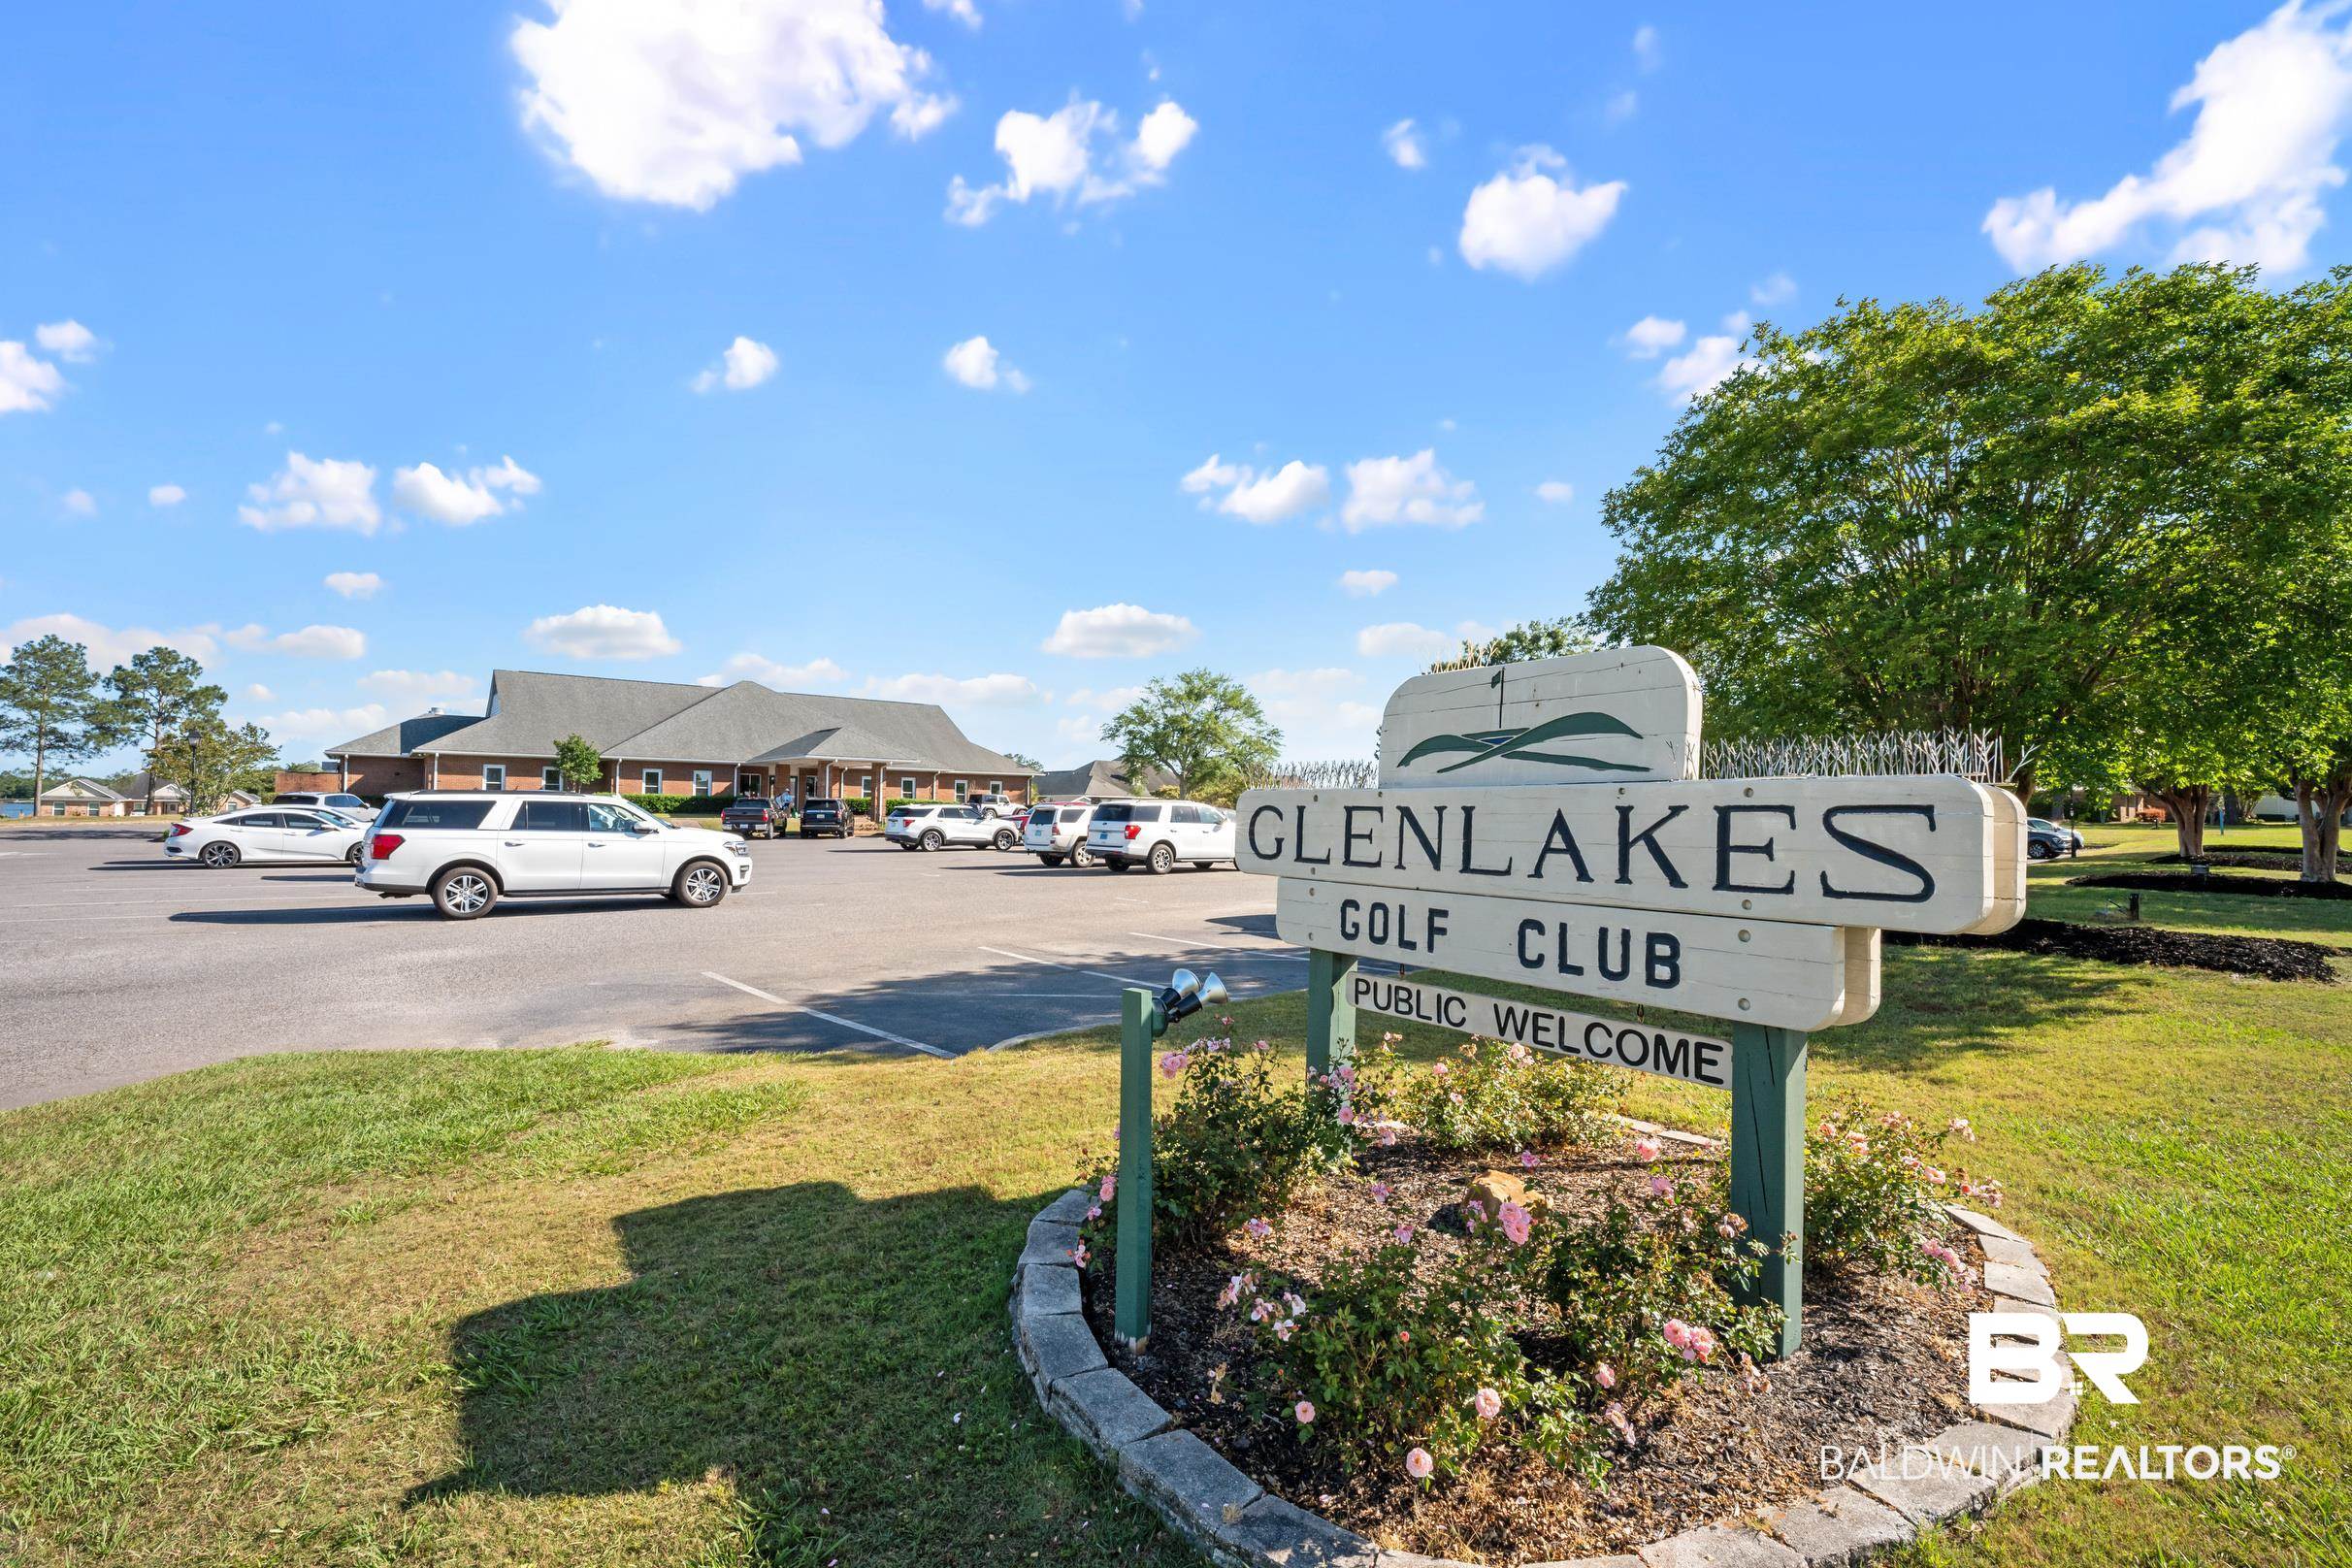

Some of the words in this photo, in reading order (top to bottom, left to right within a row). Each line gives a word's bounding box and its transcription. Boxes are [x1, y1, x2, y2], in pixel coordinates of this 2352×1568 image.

[1248, 803, 1937, 902] GLENLAKES
[1340, 898, 1450, 954] GOLF
[1517, 917, 1682, 990] CLUB
[1355, 977, 1468, 1029] PUBLIC
[1493, 1001, 1725, 1086] WELCOME
